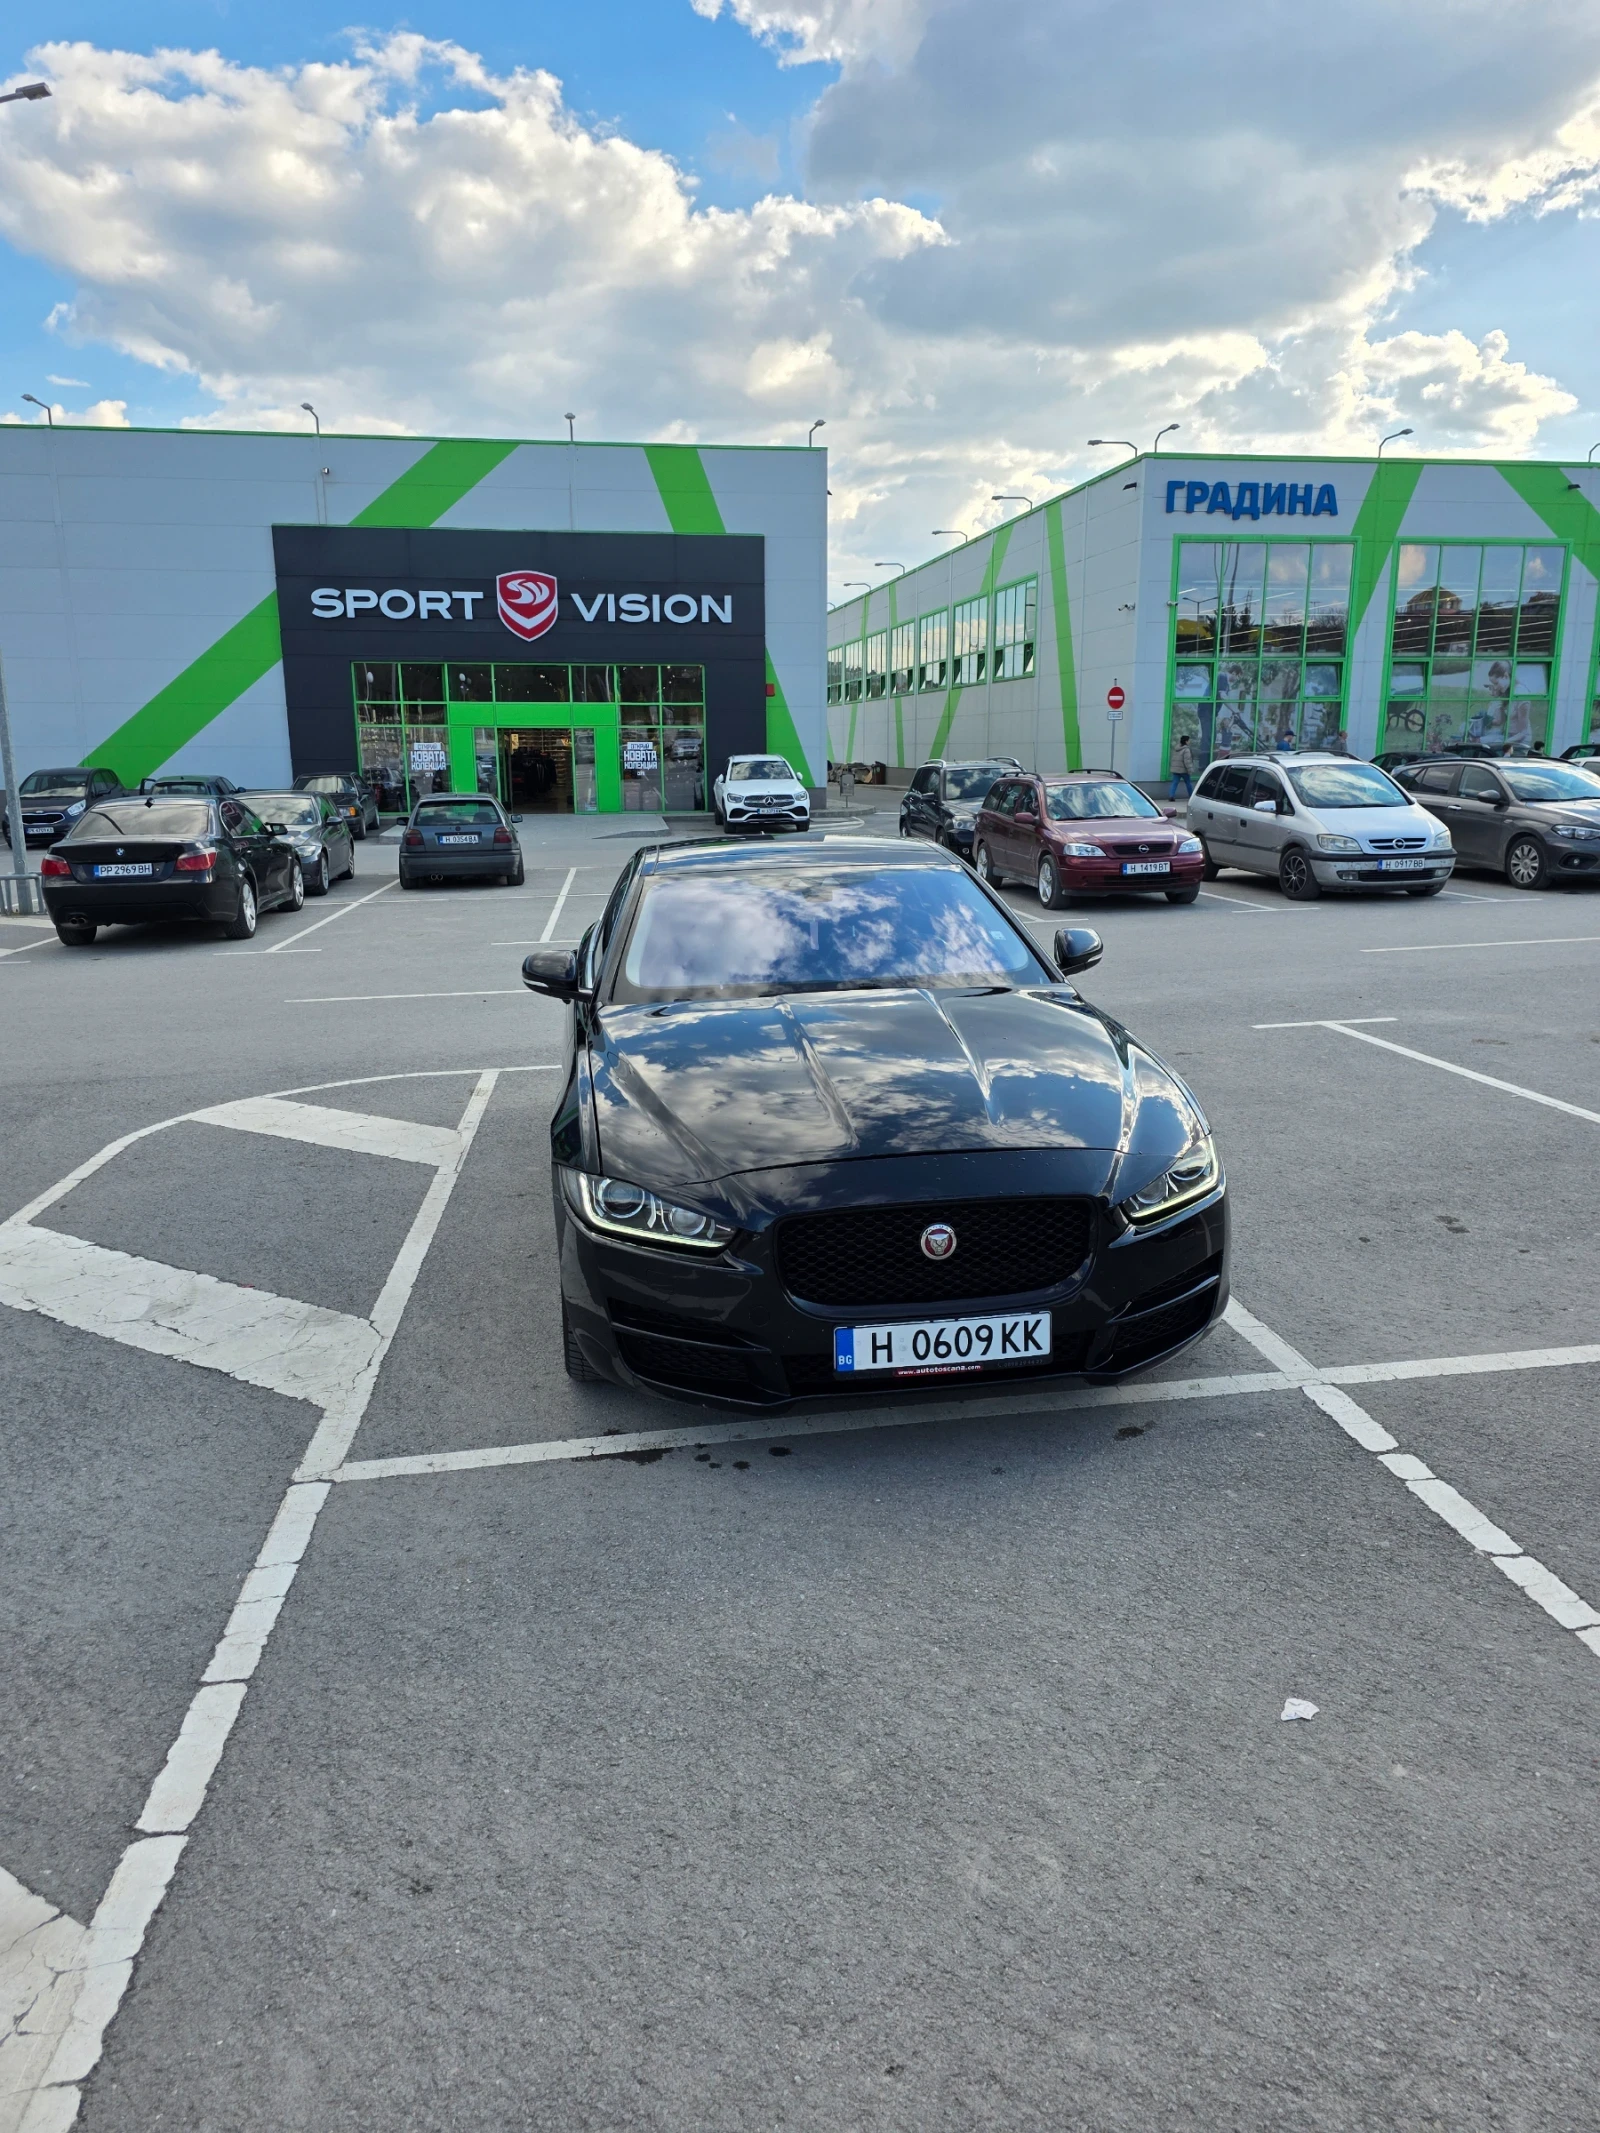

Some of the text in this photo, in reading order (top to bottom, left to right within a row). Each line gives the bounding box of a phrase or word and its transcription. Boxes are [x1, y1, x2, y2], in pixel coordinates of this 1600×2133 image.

[1166, 481, 1338, 520] ГРАДИНА
[310, 587, 733, 624] SPORT VISION
[411, 751, 446, 762] НОВАТА
[624, 750, 657, 761] НОВАТА
[838, 1355, 852, 1366] BG
[897, 1364, 981, 1376] www.autotoscana.com
